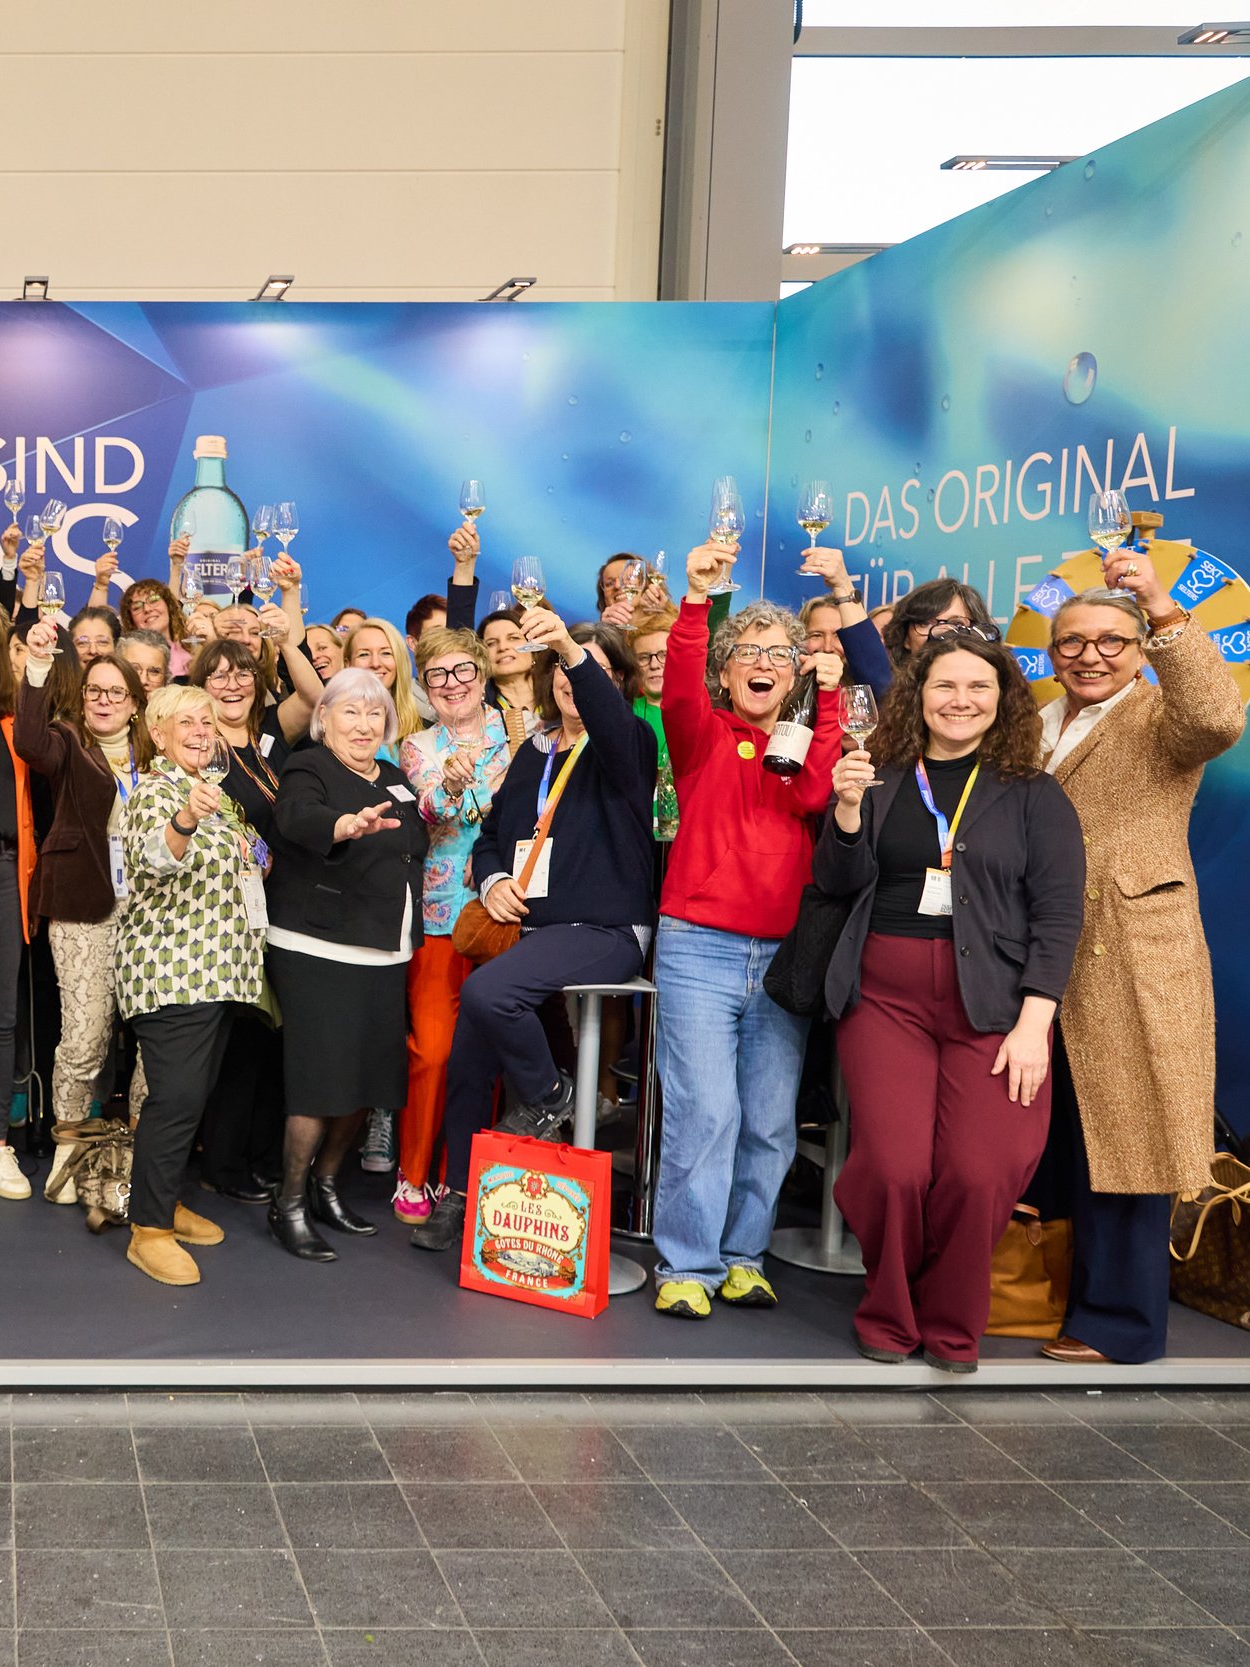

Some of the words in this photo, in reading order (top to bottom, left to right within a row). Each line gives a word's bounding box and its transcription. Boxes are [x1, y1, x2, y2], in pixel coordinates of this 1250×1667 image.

[844, 478, 921, 547] DAS
[934, 426, 1195, 533] ORIGINAL
[194, 563, 228, 576] ELTER
[1200, 560, 1224, 578] SEKT
[1031, 582, 1050, 603] SEKT
[520, 1201, 543, 1215] LES
[492, 1210, 570, 1242] DAUPHINS
[523, 1239, 534, 1251] DU
[505, 1270, 549, 1288] FRANCE
